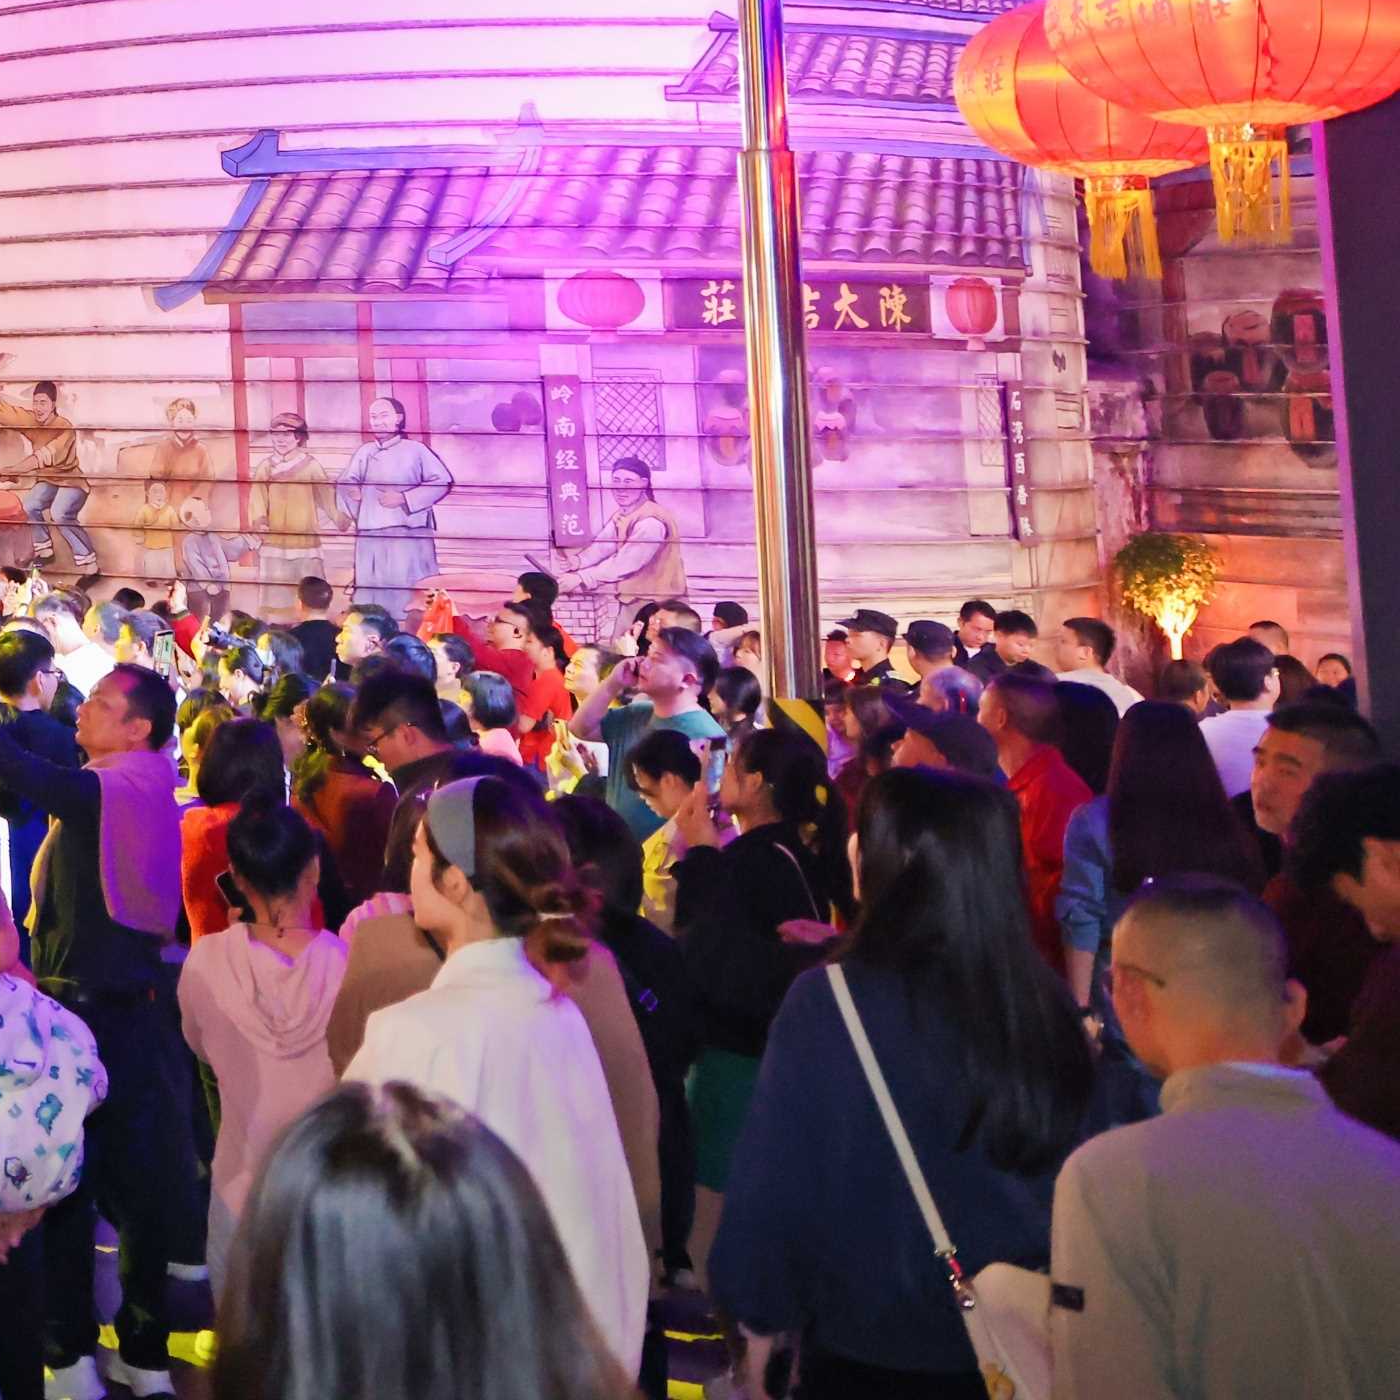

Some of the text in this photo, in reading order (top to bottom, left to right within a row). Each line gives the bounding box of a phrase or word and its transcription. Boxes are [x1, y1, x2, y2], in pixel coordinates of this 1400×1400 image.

[550, 383, 585, 536] 岭南经典范
